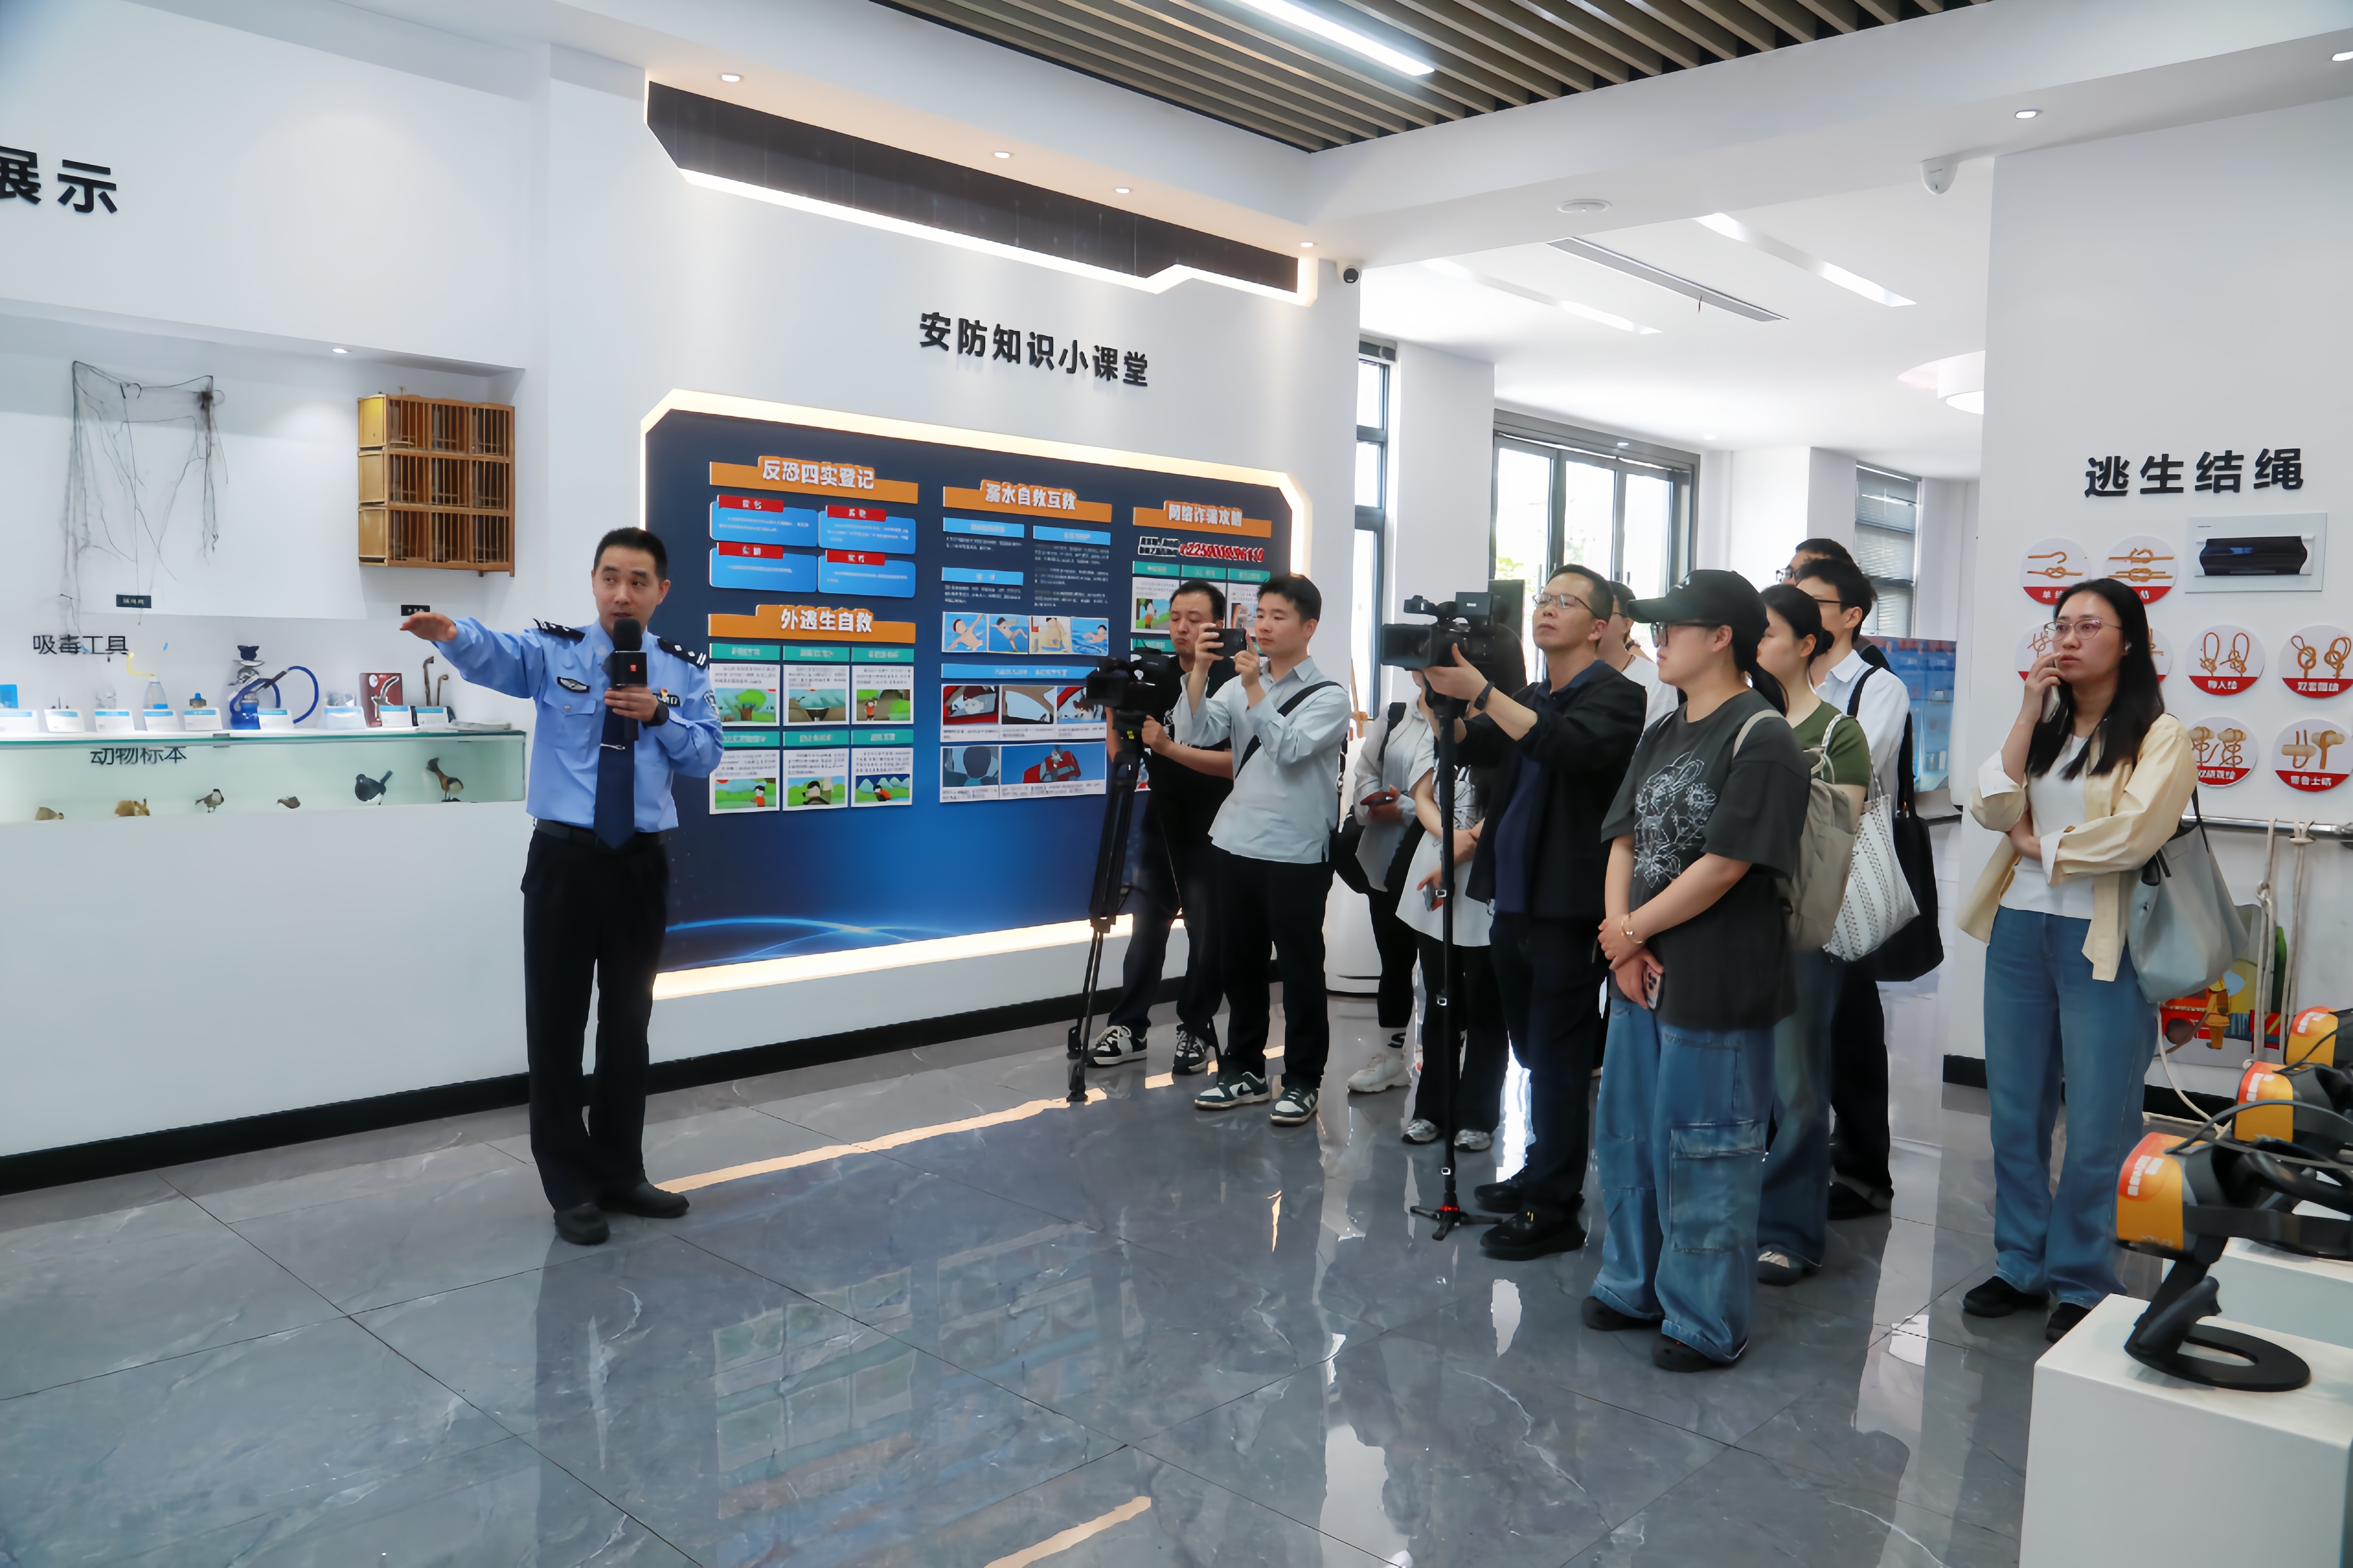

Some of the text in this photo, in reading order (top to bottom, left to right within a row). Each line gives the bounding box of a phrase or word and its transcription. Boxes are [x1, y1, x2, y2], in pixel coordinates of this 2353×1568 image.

[919, 312, 1148, 387] 安防知识小课堂
[762, 460, 874, 489] 反恐四实登记
[2084, 448, 2304, 498] 逃生结绳
[33, 634, 130, 655] 吸毒工具
[91, 746, 187, 765] 动物标本
